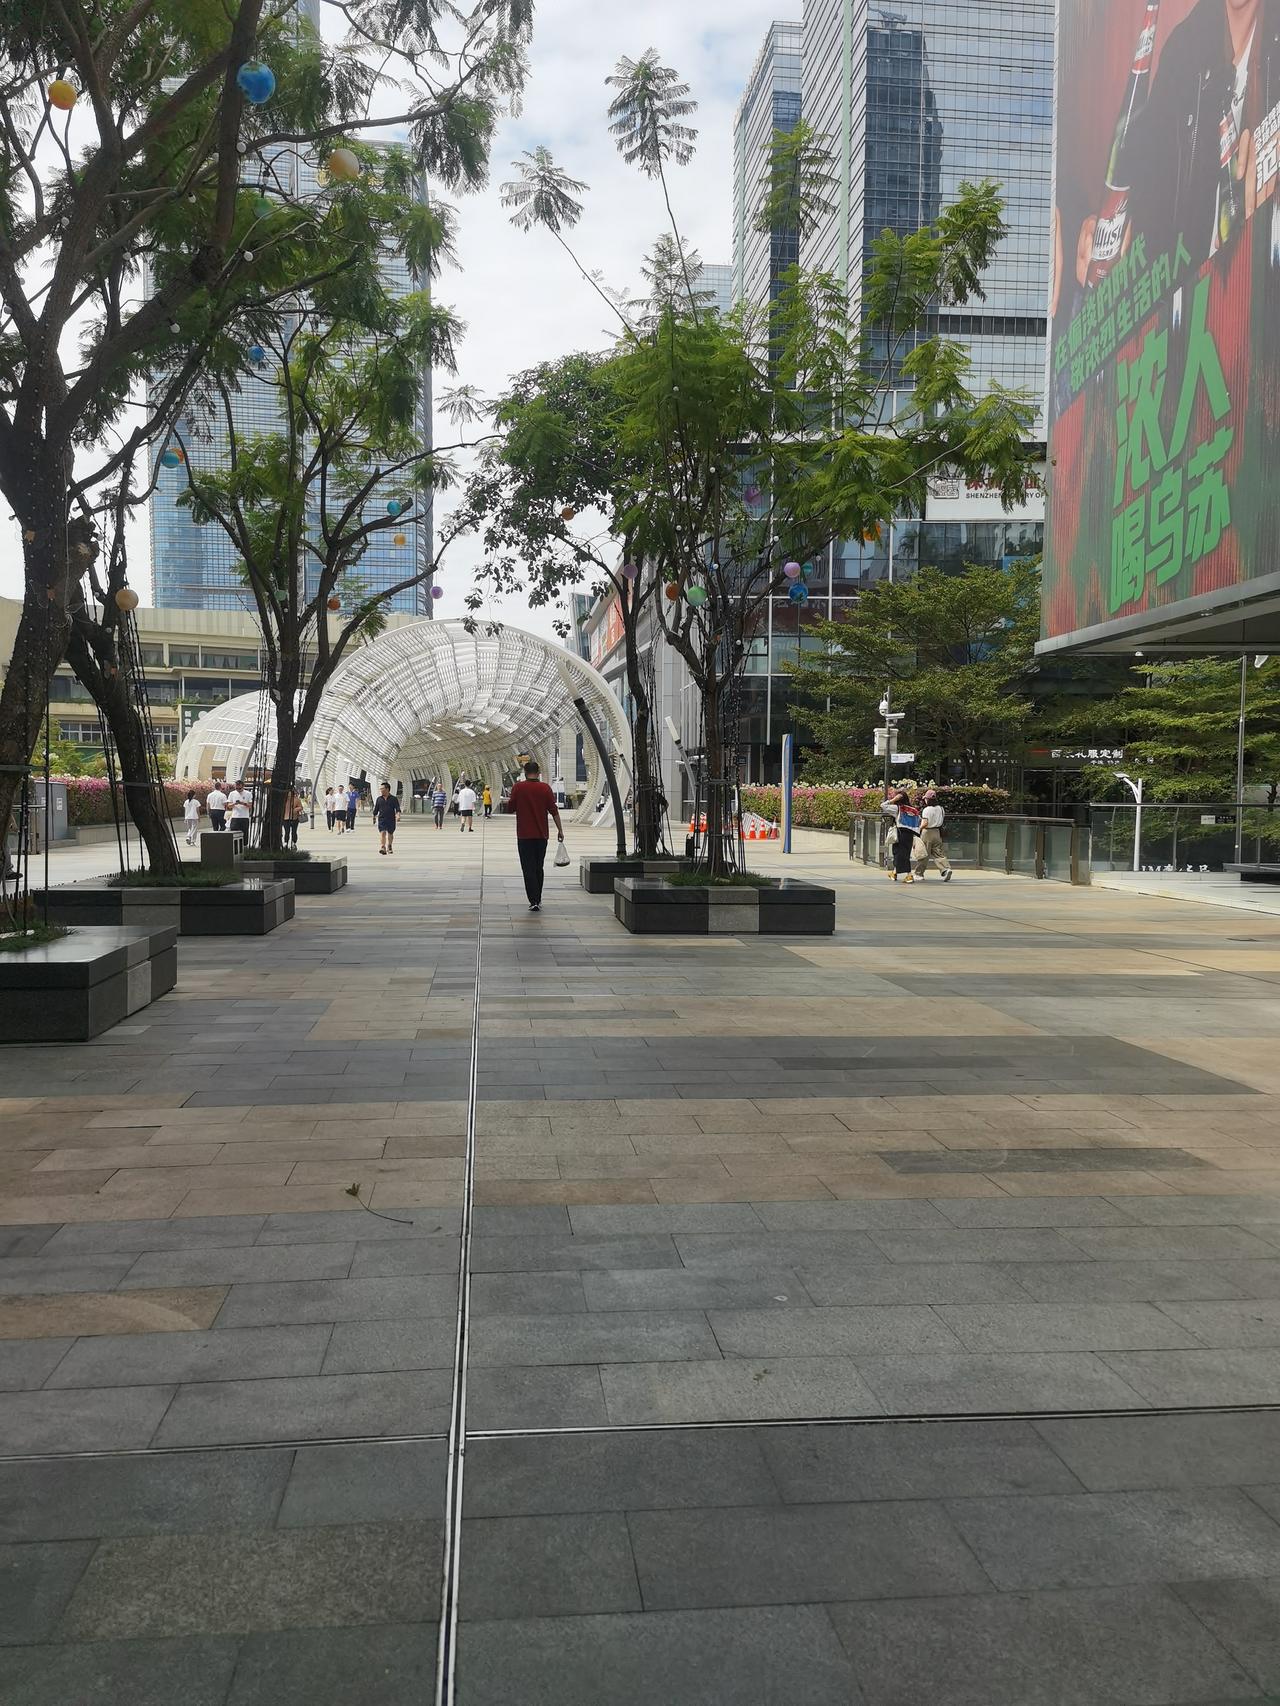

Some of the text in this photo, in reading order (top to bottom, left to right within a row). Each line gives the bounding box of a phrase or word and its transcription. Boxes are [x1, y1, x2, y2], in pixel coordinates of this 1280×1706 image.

[1256, 140, 1280, 192] 范
[1113, 275, 1231, 509] 浓人
[1109, 424, 1233, 614] 喝乌苏
